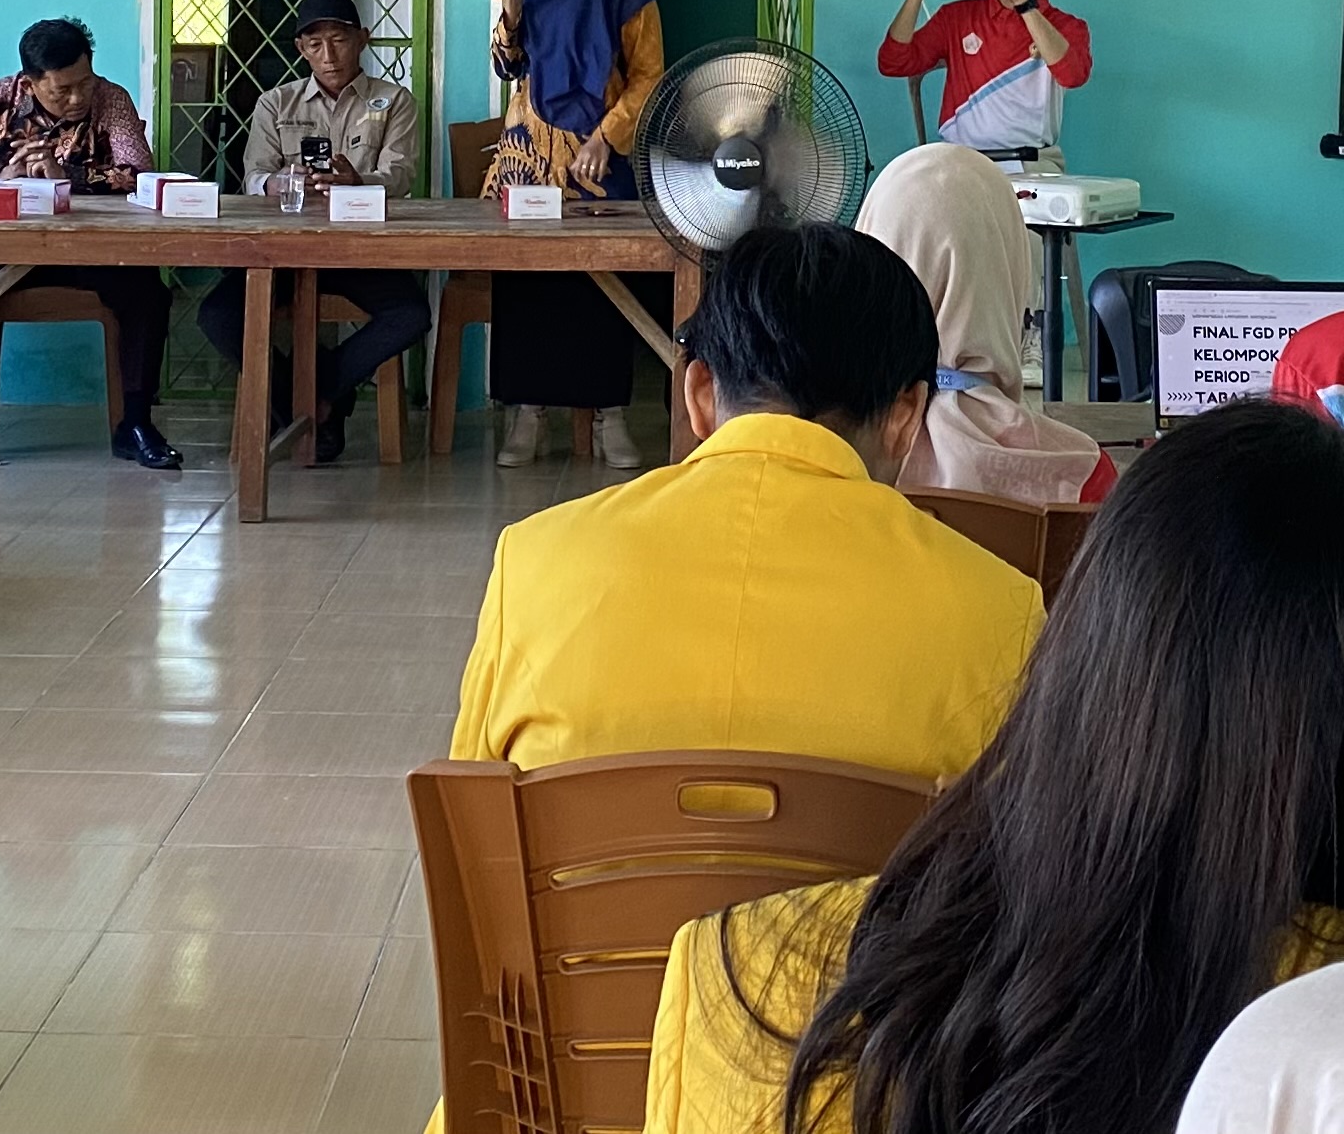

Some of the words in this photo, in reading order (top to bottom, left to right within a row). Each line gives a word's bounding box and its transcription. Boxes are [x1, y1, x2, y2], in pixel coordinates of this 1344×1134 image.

[725, 158, 760, 170] Miyako
[1193, 326, 1238, 339] FINAL
[1243, 326, 1274, 339] FGD
[1194, 349, 1279, 362] KELOMPOK
[1194, 370, 1260, 383] PERIOD
